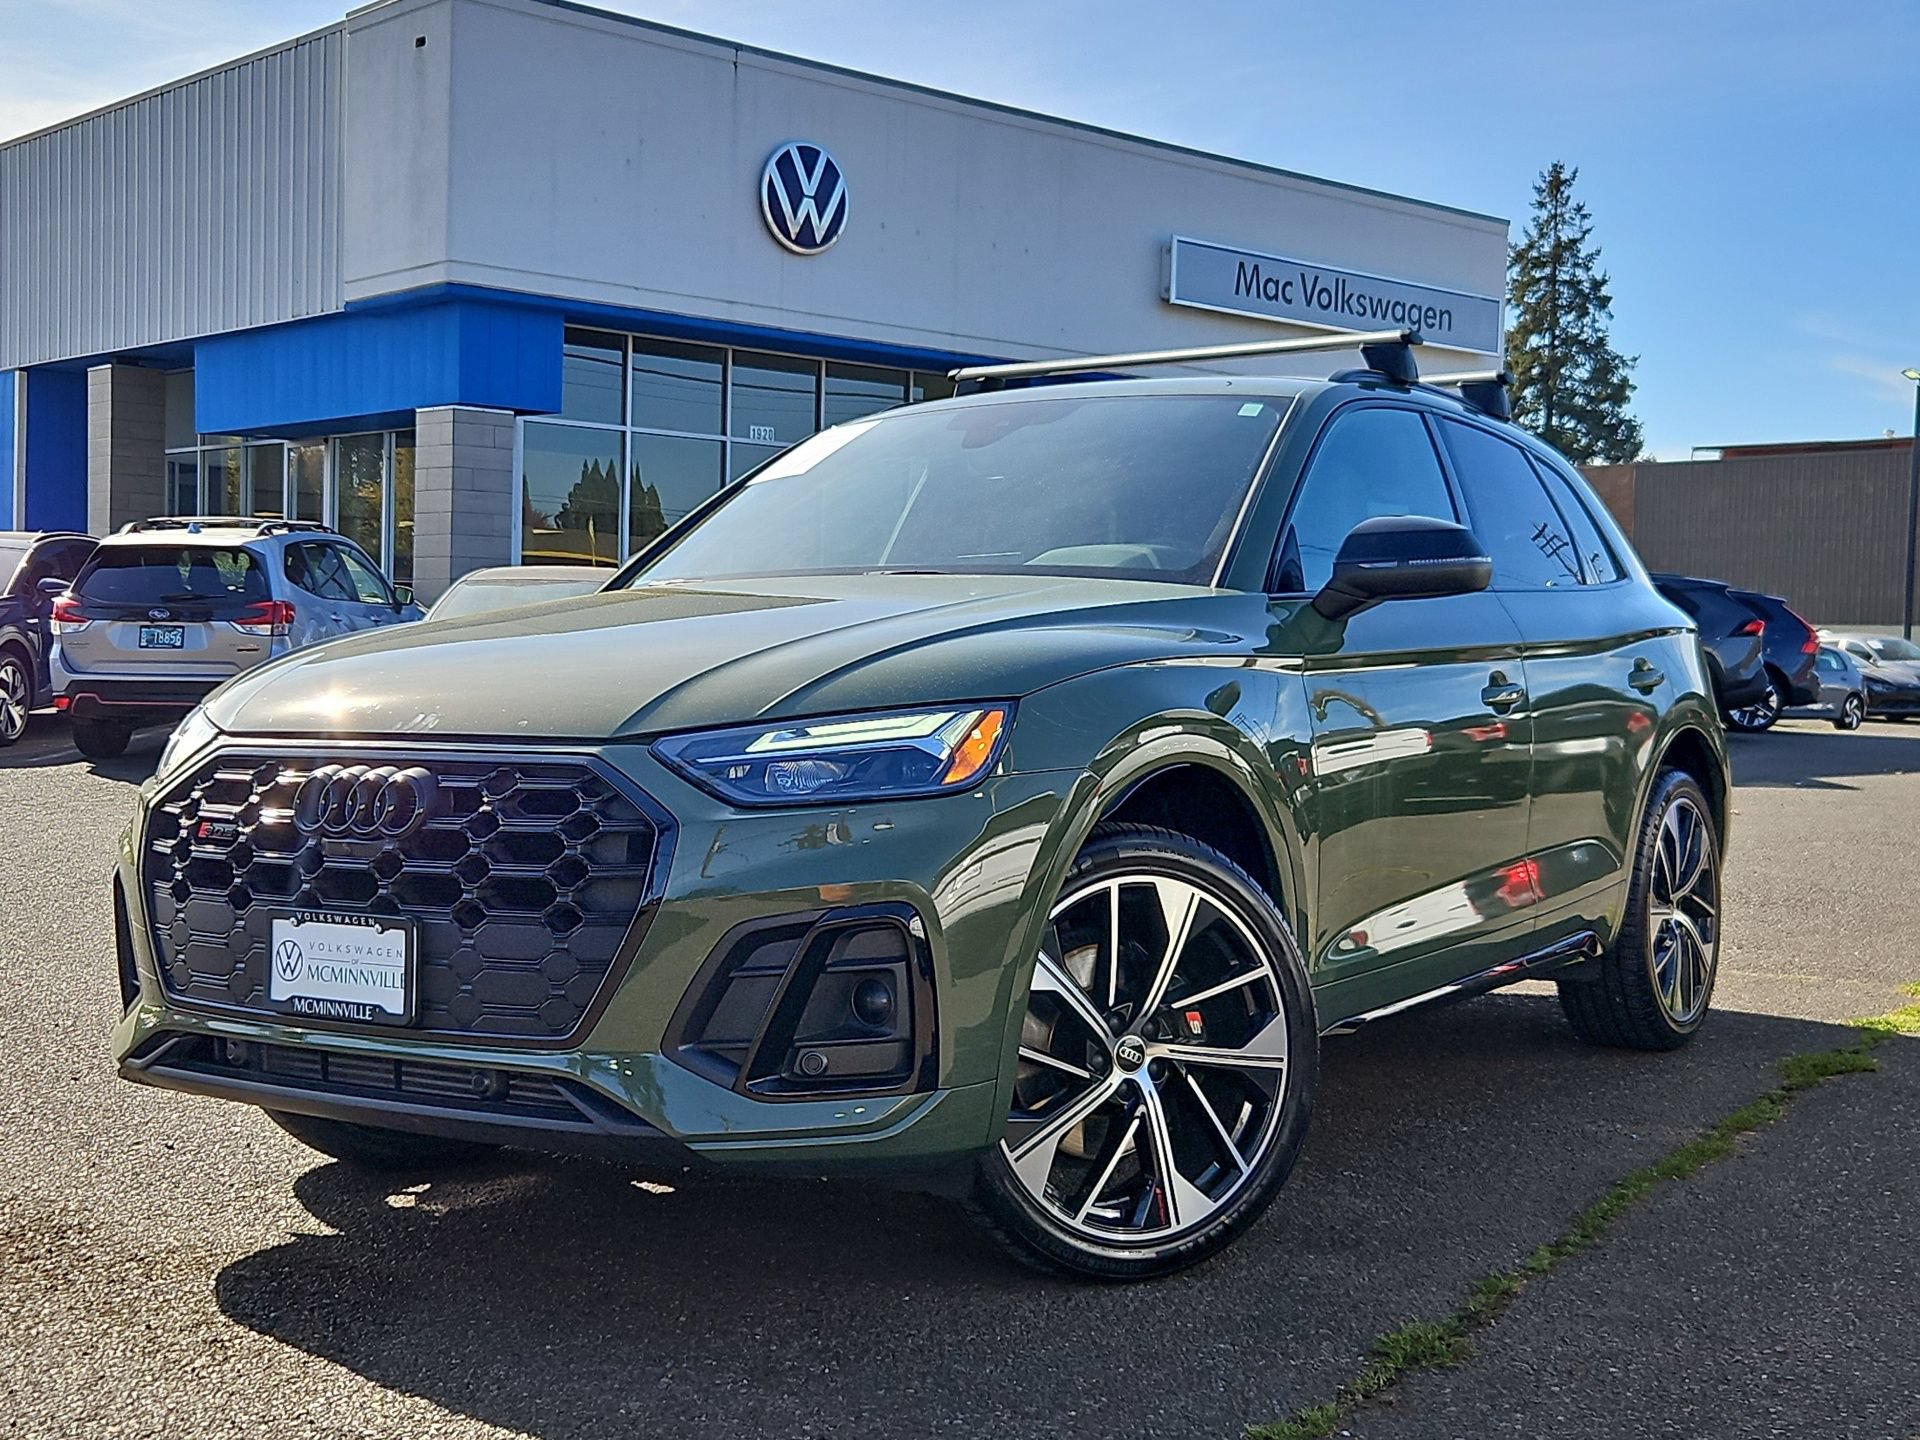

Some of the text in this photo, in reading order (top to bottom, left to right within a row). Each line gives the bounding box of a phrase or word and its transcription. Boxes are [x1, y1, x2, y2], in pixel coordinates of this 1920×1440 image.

[1234, 261, 1452, 333] Mac Volkswagen
[751, 427, 774, 441] 1920
[296, 912, 375, 925] VOLKSWAGEN
[309, 942, 402, 958] VOLKSWAGEN
[293, 999, 373, 1020] MCMINNVILLE
